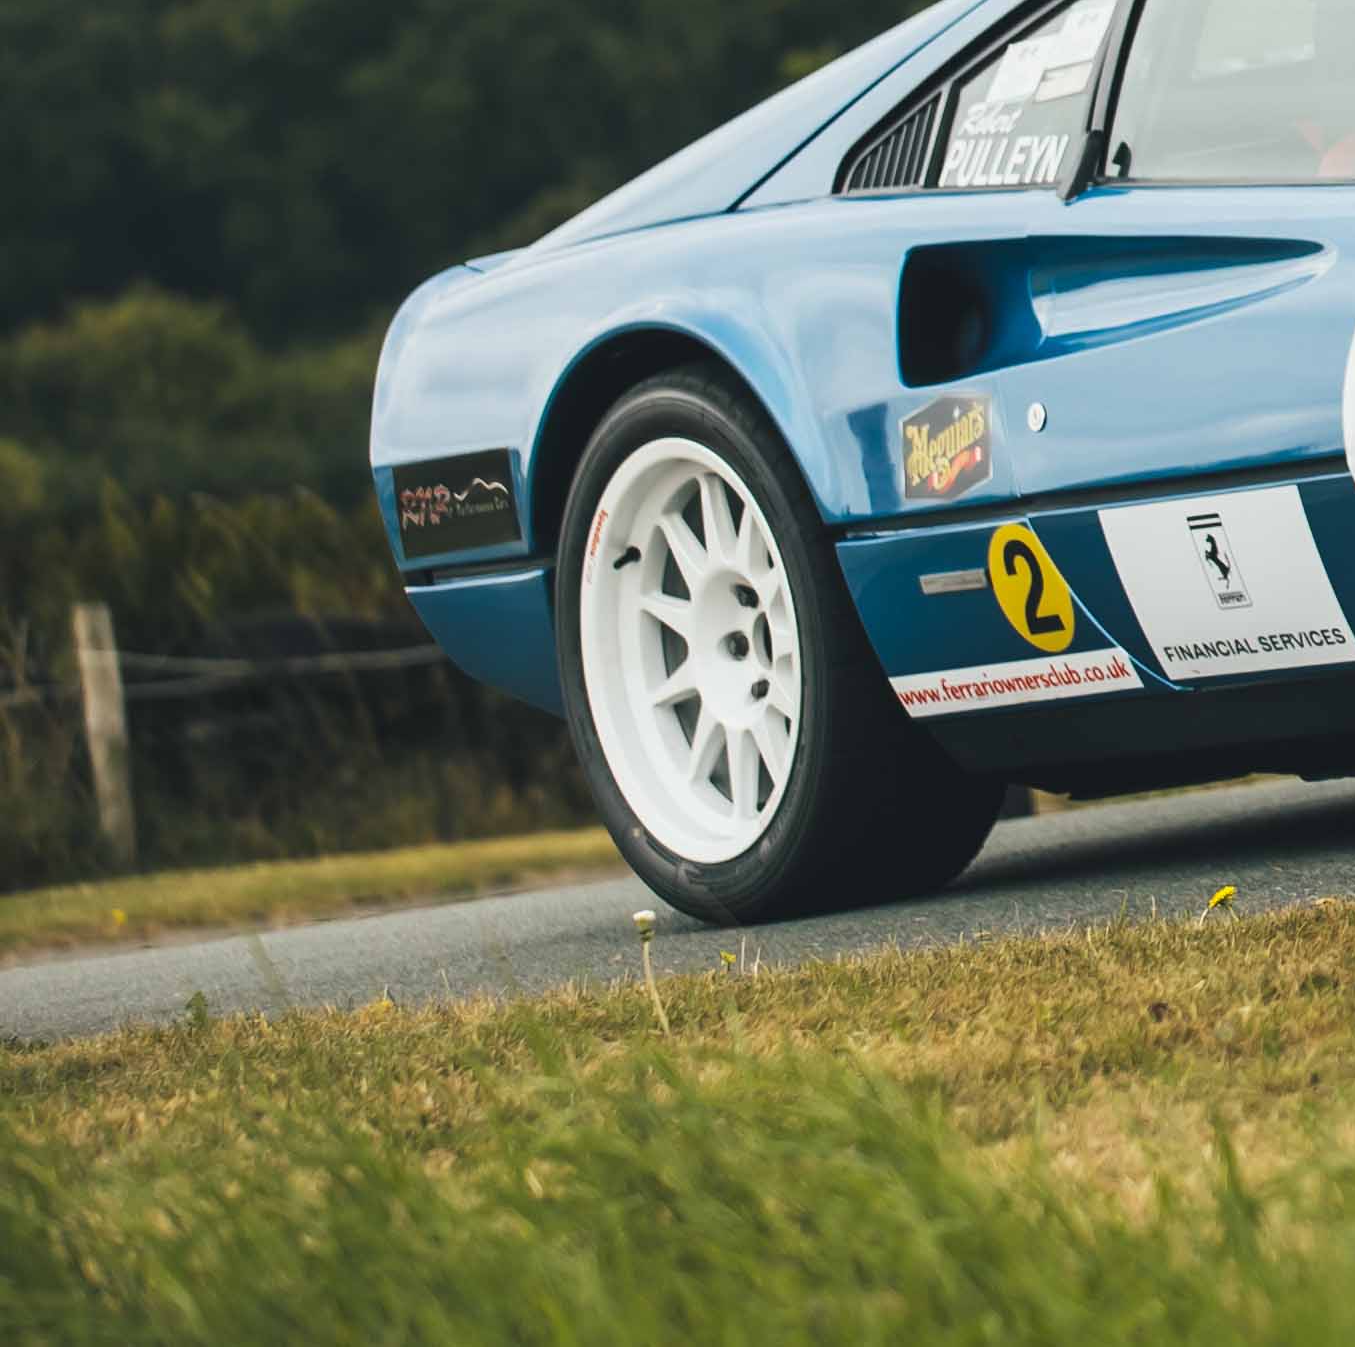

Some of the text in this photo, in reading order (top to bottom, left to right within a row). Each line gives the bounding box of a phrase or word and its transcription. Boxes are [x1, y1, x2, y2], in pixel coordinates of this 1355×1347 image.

[938, 134, 1069, 188] PULLEYN
[1003, 539, 1065, 636] 2
[1162, 627, 1347, 663] FINANCIAL SERVICES
[899, 655, 1131, 707] www.ferrariownersclub.co.uk
